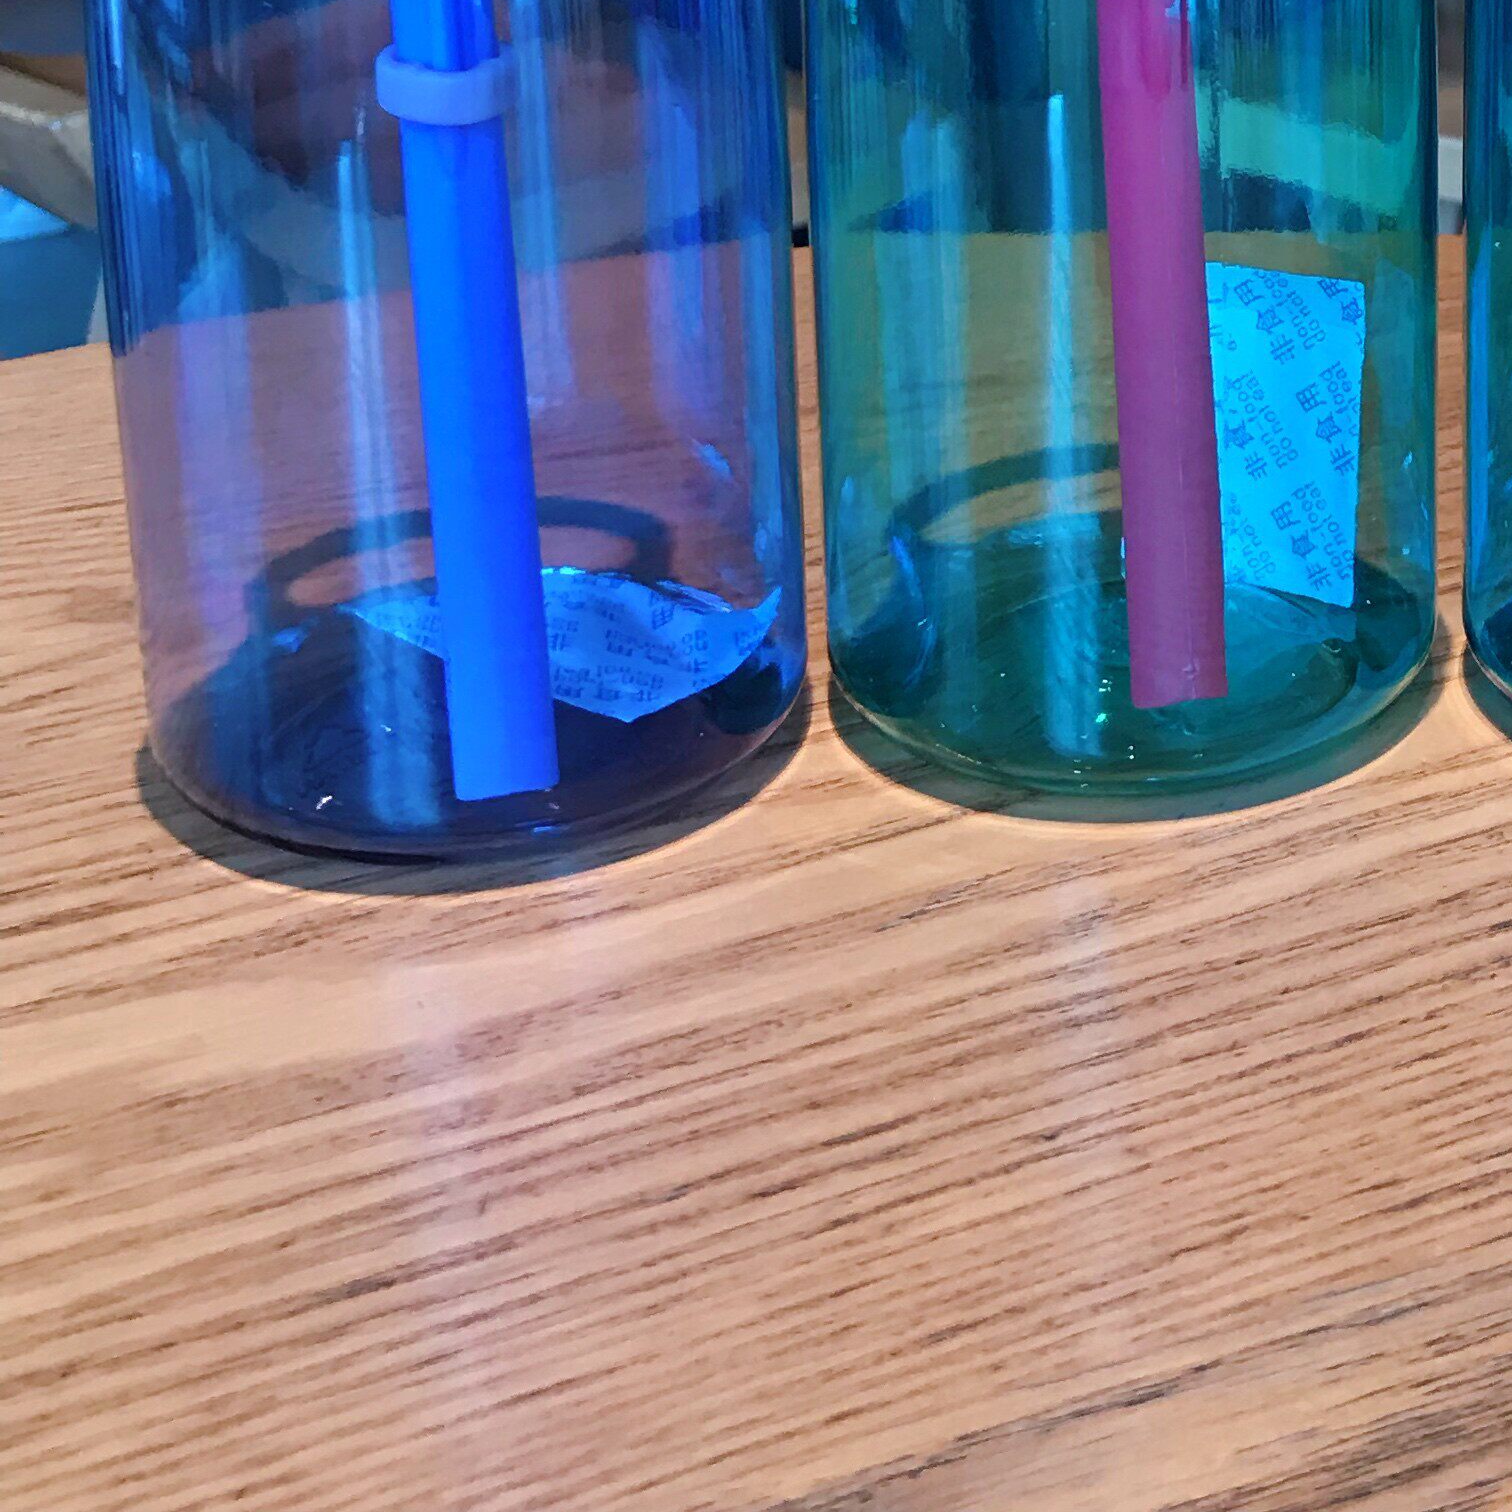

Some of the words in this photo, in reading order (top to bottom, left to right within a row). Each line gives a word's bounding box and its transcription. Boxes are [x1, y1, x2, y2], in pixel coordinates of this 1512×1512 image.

[1234, 276, 1296, 366] 非食用
[1259, 405, 1285, 435] not
[1296, 383, 1362, 478] 非食用
[1271, 501, 1333, 592] 非食用
